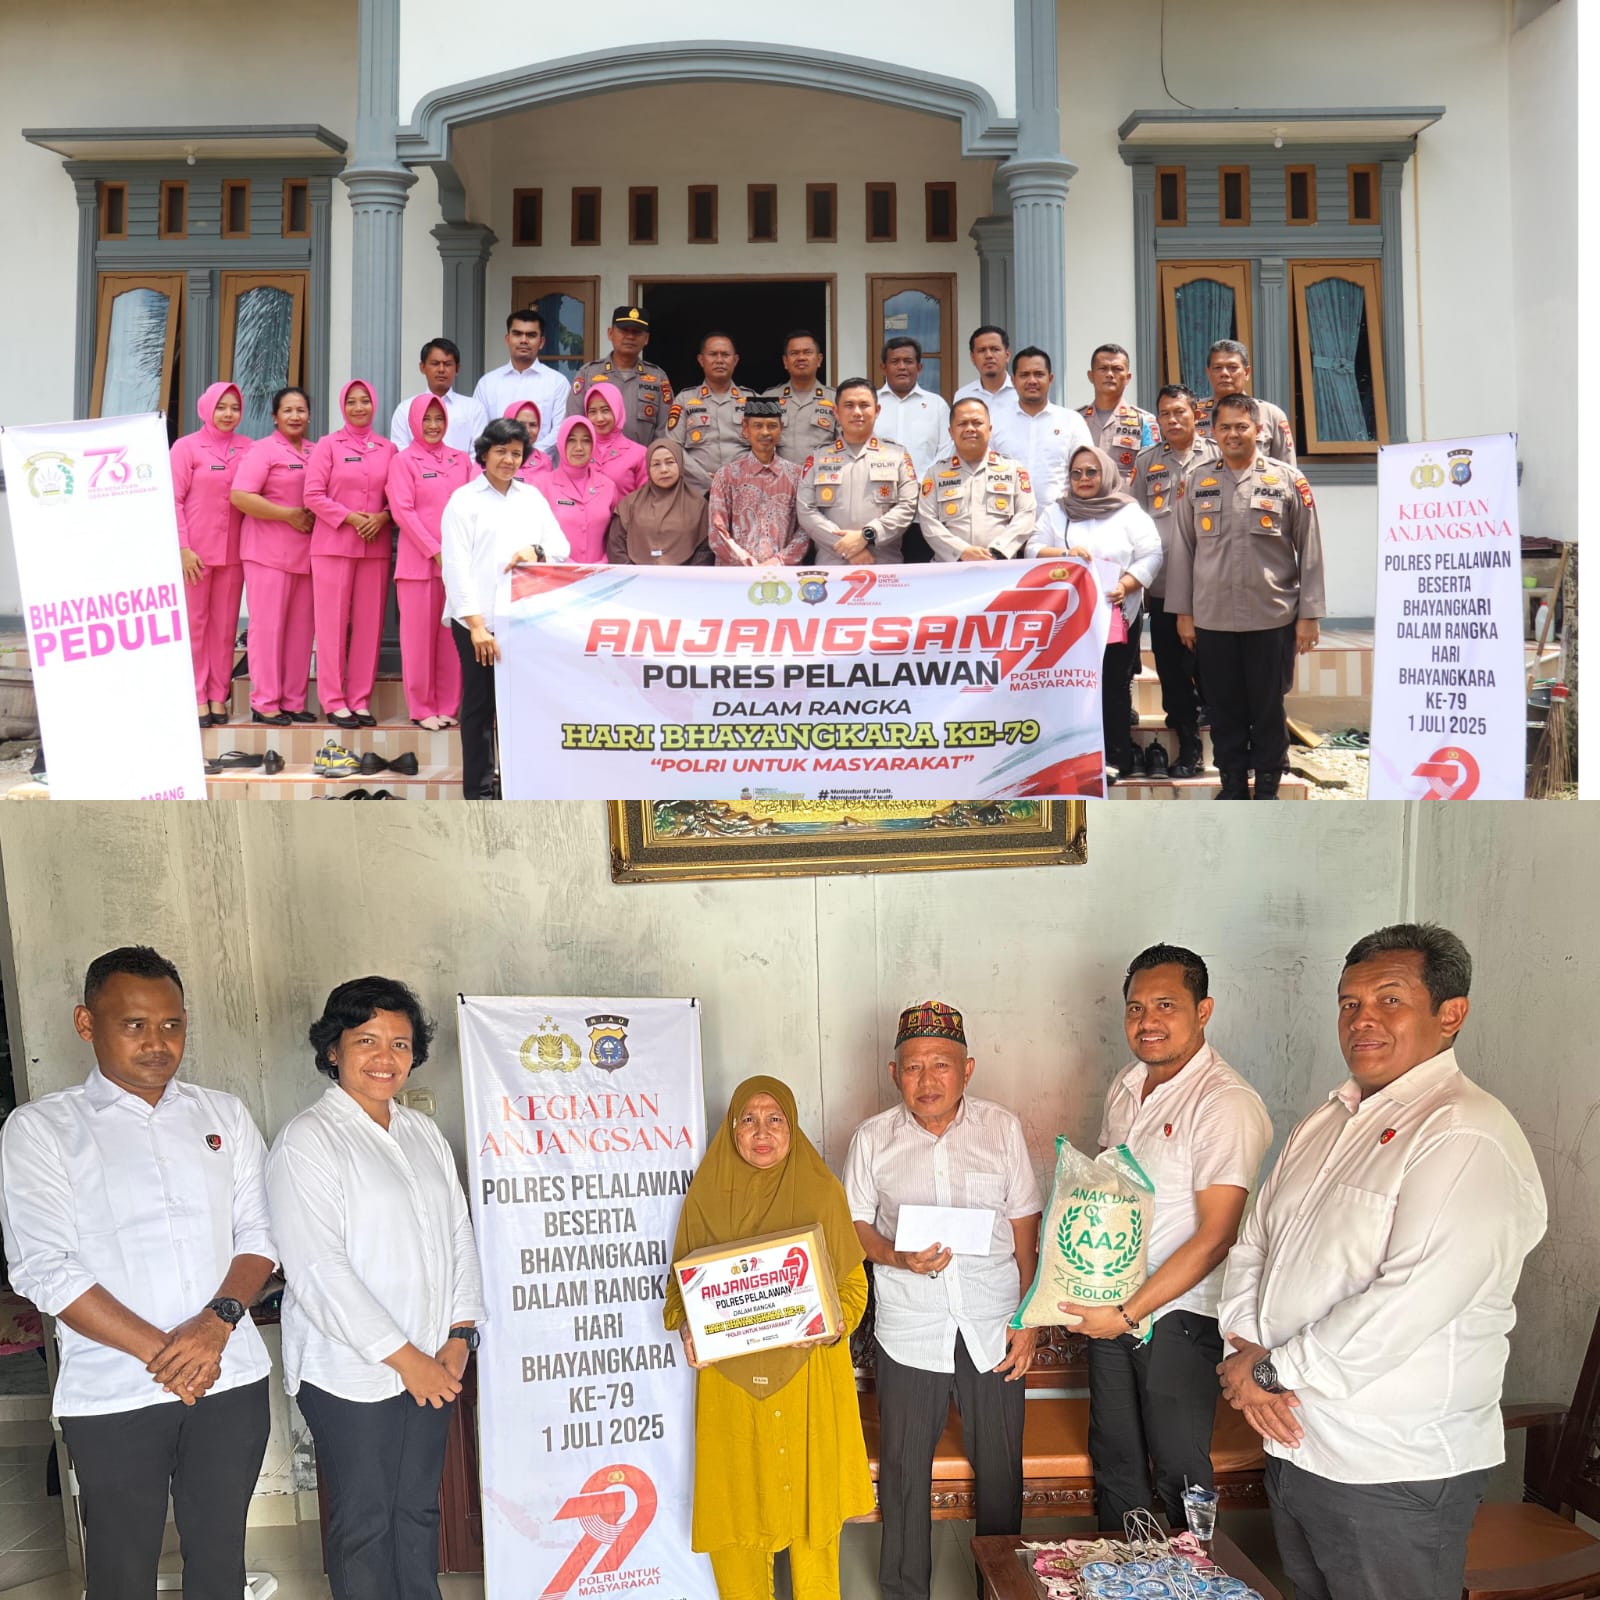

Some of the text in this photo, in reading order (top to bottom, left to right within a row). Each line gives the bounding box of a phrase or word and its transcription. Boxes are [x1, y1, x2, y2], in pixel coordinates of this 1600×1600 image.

[1399, 498, 1490, 520] KEGIATAN
[1385, 520, 1513, 542] ANJANGSANA
[1385, 550, 1512, 571] POLRES PELALAWAN
[1418, 575, 1472, 593] BESERTA
[30, 583, 178, 631] BHAYANGKARI
[1403, 598, 1491, 616] BHAYANGKARI
[34, 610, 183, 667] PEDULI
[583, 613, 1053, 656] ANJANGSANA
[1397, 622, 1498, 640] DALAM RANGKA
[1432, 646, 1460, 663] HARI
[643, 659, 999, 689] POLRES PELALAWAN
[1009, 678, 1098, 692] MASYARAKAT
[1010, 668, 1097, 681] POLRI UNTUK
[1399, 668, 1496, 687] BHAYANGKARA
[712, 699, 912, 716] DALAM RANGKA
[1426, 692, 1467, 710] KE-79
[562, 719, 1041, 751] HARI BHAYANGKARA KE-79
[1408, 715, 1487, 735] 1 JULI 2025
[733, 757, 807, 772] UNTUK
[590, 1016, 624, 1025] RIAU
[502, 1093, 659, 1121] KEGIATAN
[480, 1125, 696, 1157] ANJANGSANA
[482, 1170, 694, 1205] POLRES PELALAWAN
[1070, 1187, 1107, 1204] ANAK
[544, 1207, 637, 1238] BESERTA
[1075, 1229, 1127, 1250] AA2
[520, 1240, 667, 1275] BHAYANGKARI
[512, 1274, 671, 1311] DALAM RANGK
[701, 1266, 800, 1300] ANJANGSANA
[1072, 1285, 1122, 1300] SOLOK
[715, 1295, 745, 1310] POLRES
[744, 1285, 793, 1304] PELALAWAN
[733, 1302, 776, 1317] DALAM RANGKA
[574, 1312, 624, 1342] HARI
[521, 1343, 676, 1383] BHAYANGKARA
[569, 1382, 635, 1413] KE-79
[542, 1413, 665, 1452] 1 JULI 2025
[578, 1566, 661, 1587] POLRI UNTUK
[578, 1575, 662, 1597] MASYARAKAT
